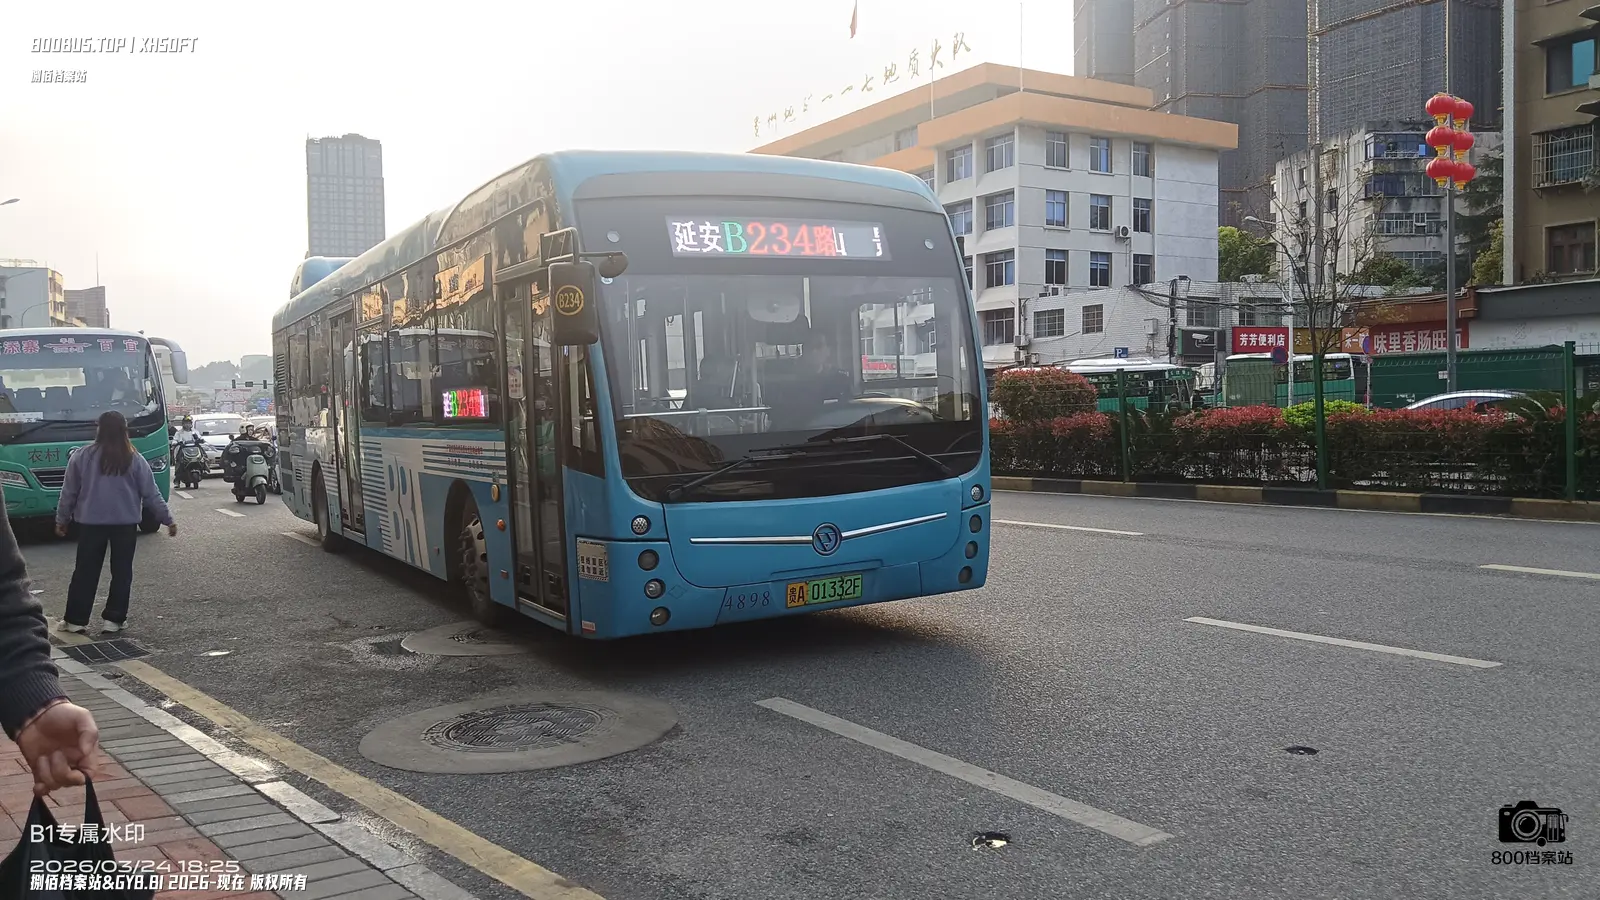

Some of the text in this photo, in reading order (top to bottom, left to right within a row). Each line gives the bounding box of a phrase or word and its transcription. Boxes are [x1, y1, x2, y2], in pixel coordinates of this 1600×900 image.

[559, 293, 580, 309] B234
[0, 340, 40, 354] 添寨
[1240, 333, 1285, 346] 芳芳便利店
[28, 448, 60, 463] 农村
[789, 578, 861, 604] 贵A 01332F
[725, 591, 770, 610] 4898
